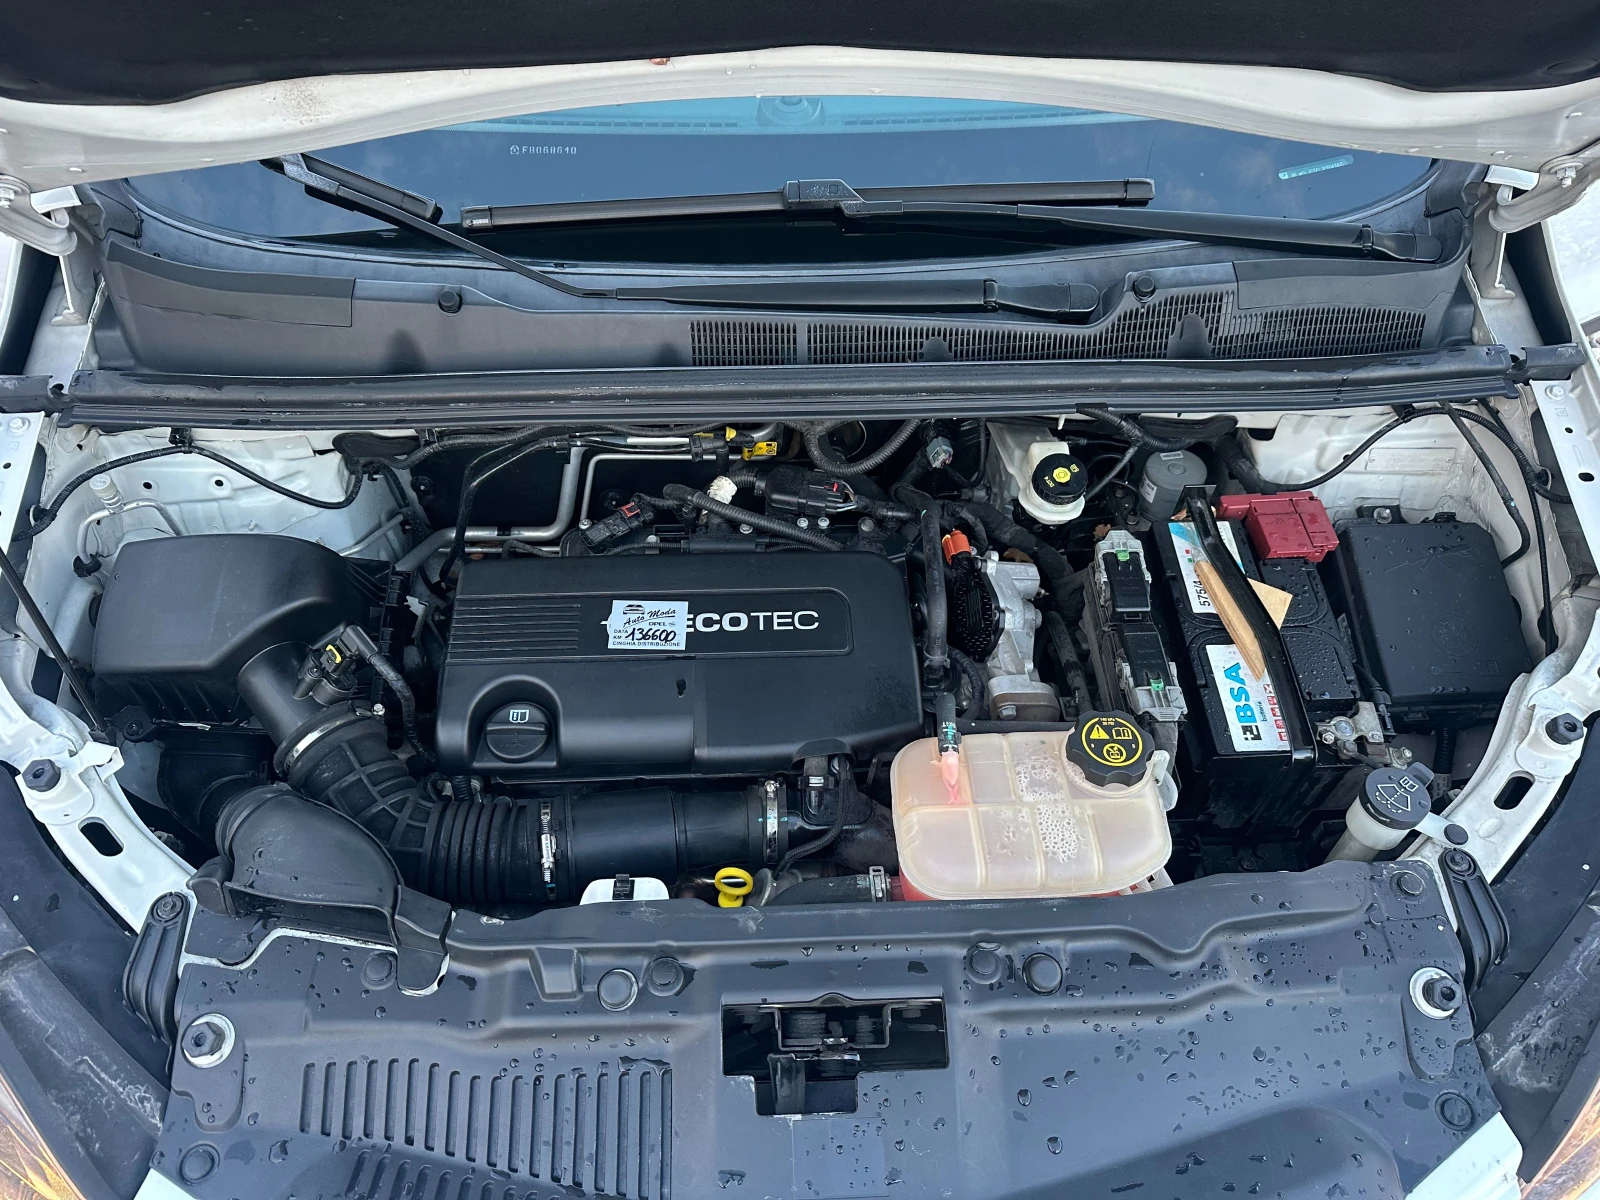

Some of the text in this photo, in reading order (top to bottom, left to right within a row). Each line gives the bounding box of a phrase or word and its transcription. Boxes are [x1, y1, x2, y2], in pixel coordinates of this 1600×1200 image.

[622, 608, 676, 628] Auto Moda
[625, 627, 677, 644] 136600
[1223, 662, 1257, 723] BSA
